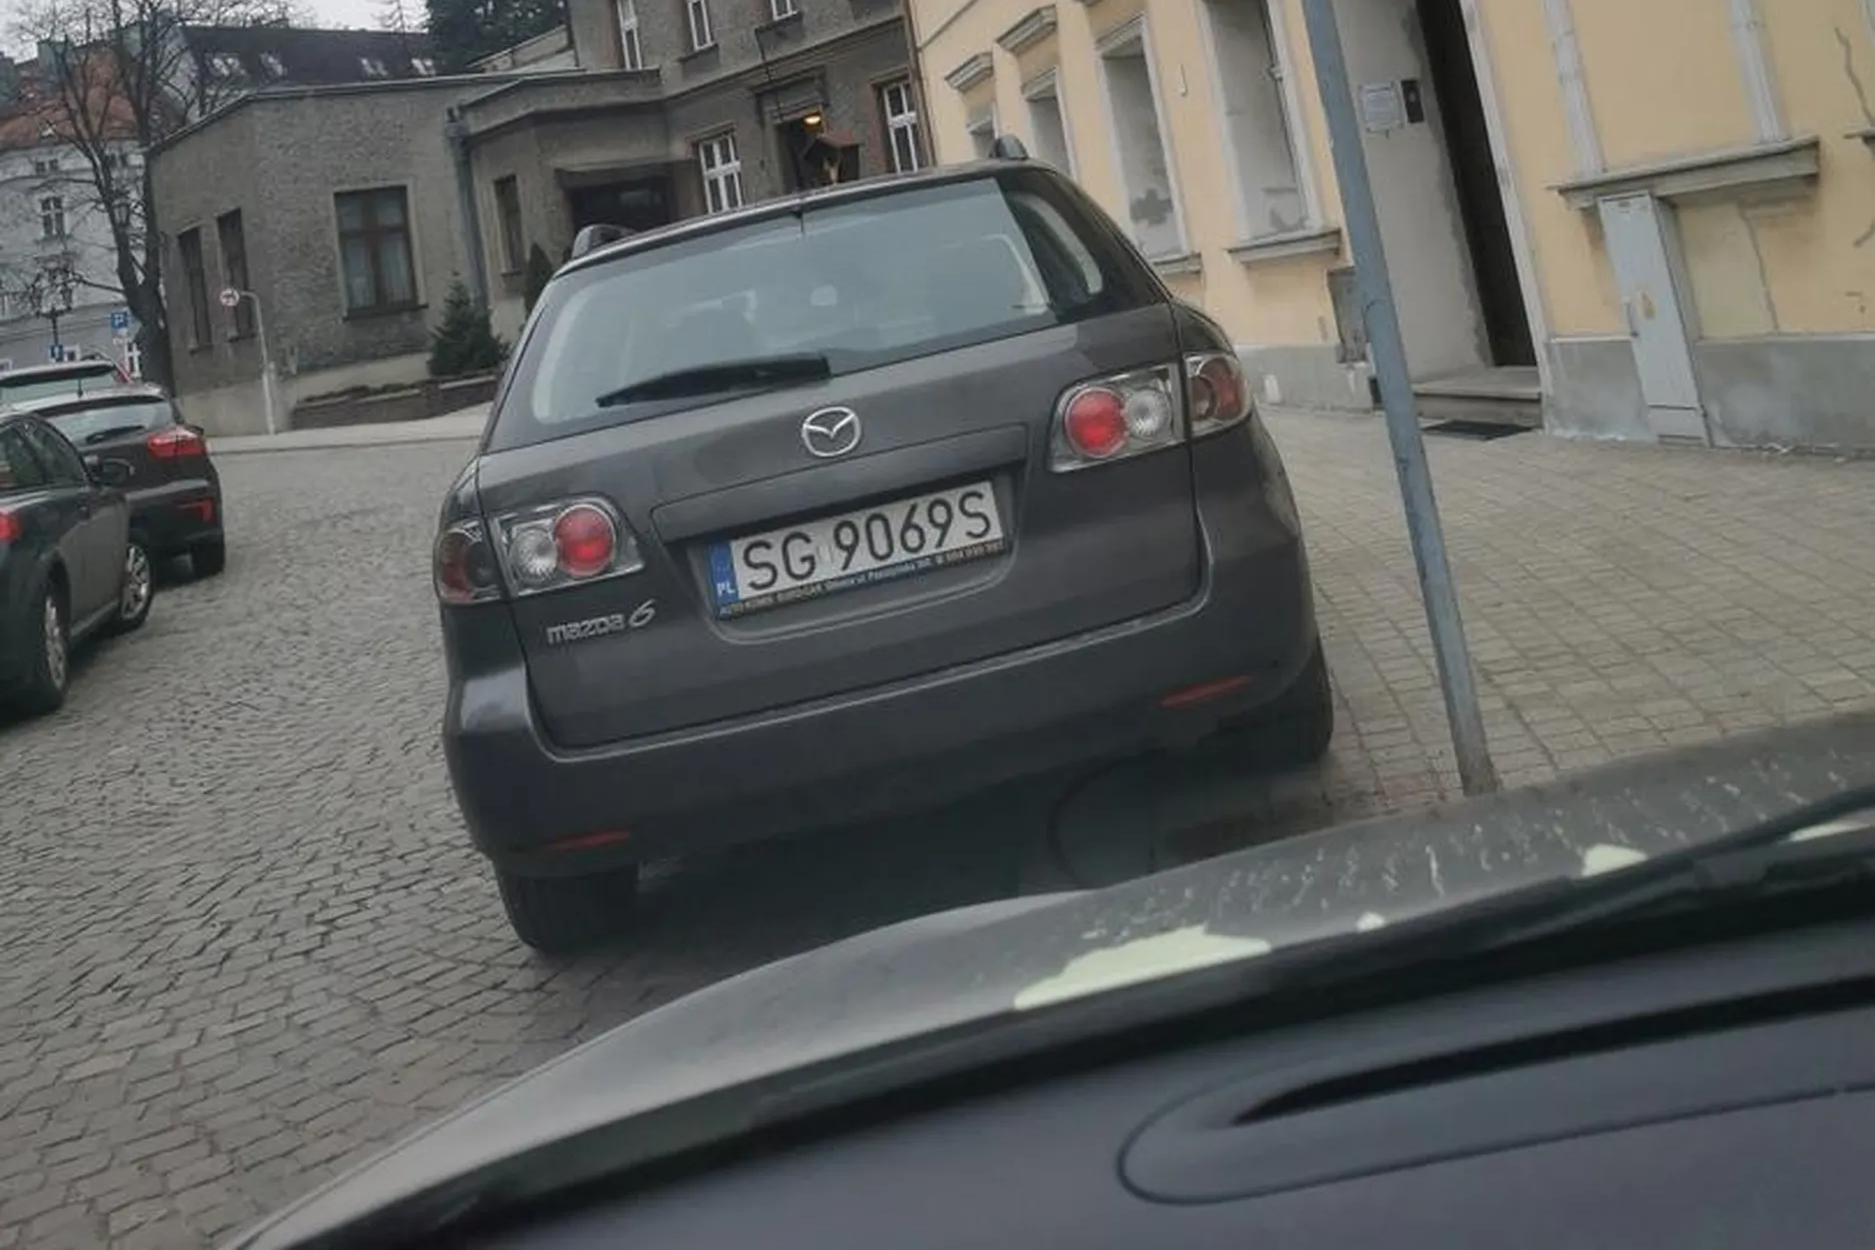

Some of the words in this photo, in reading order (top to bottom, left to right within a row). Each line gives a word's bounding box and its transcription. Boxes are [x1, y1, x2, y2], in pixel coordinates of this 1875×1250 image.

[742, 531, 817, 591] SG
[832, 491, 992, 572] 9069S
[716, 581, 736, 596] PL
[628, 599, 657, 628] 6
